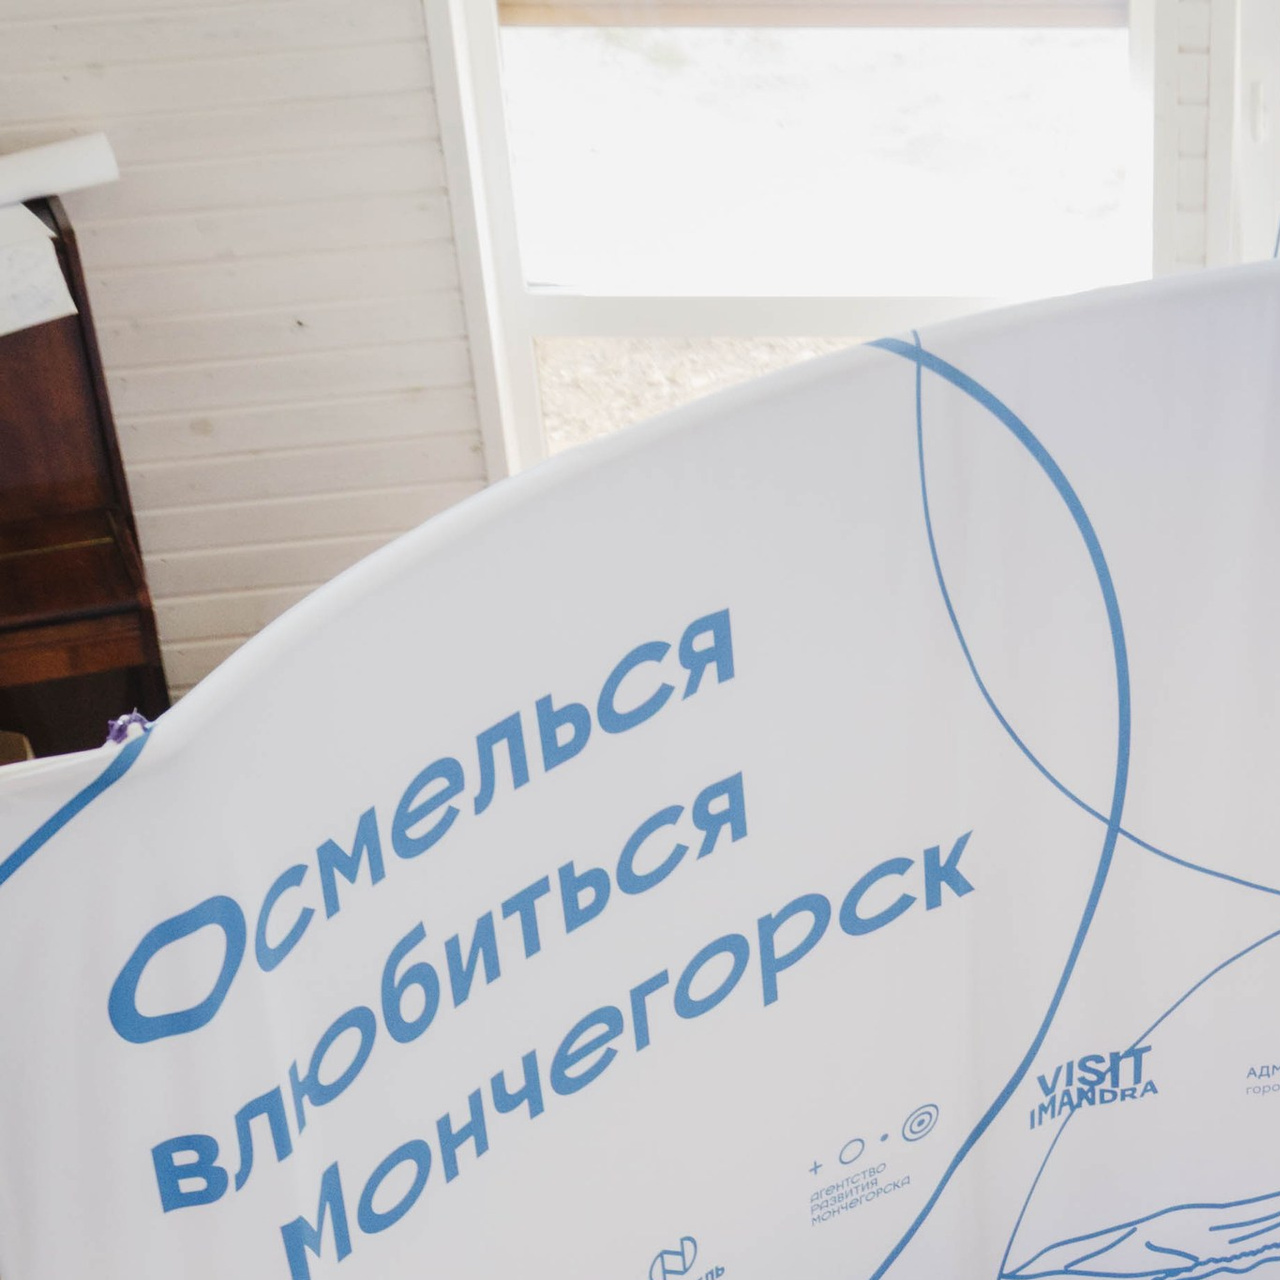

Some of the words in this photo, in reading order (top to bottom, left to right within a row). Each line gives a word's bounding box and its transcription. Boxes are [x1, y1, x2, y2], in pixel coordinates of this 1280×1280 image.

[107, 607, 736, 1044] Осмелься
[150, 771, 749, 1214] влюбиться
[1029, 1079, 1158, 1130] IMANDRA
[1036, 1044, 1152, 1097] VISIT
